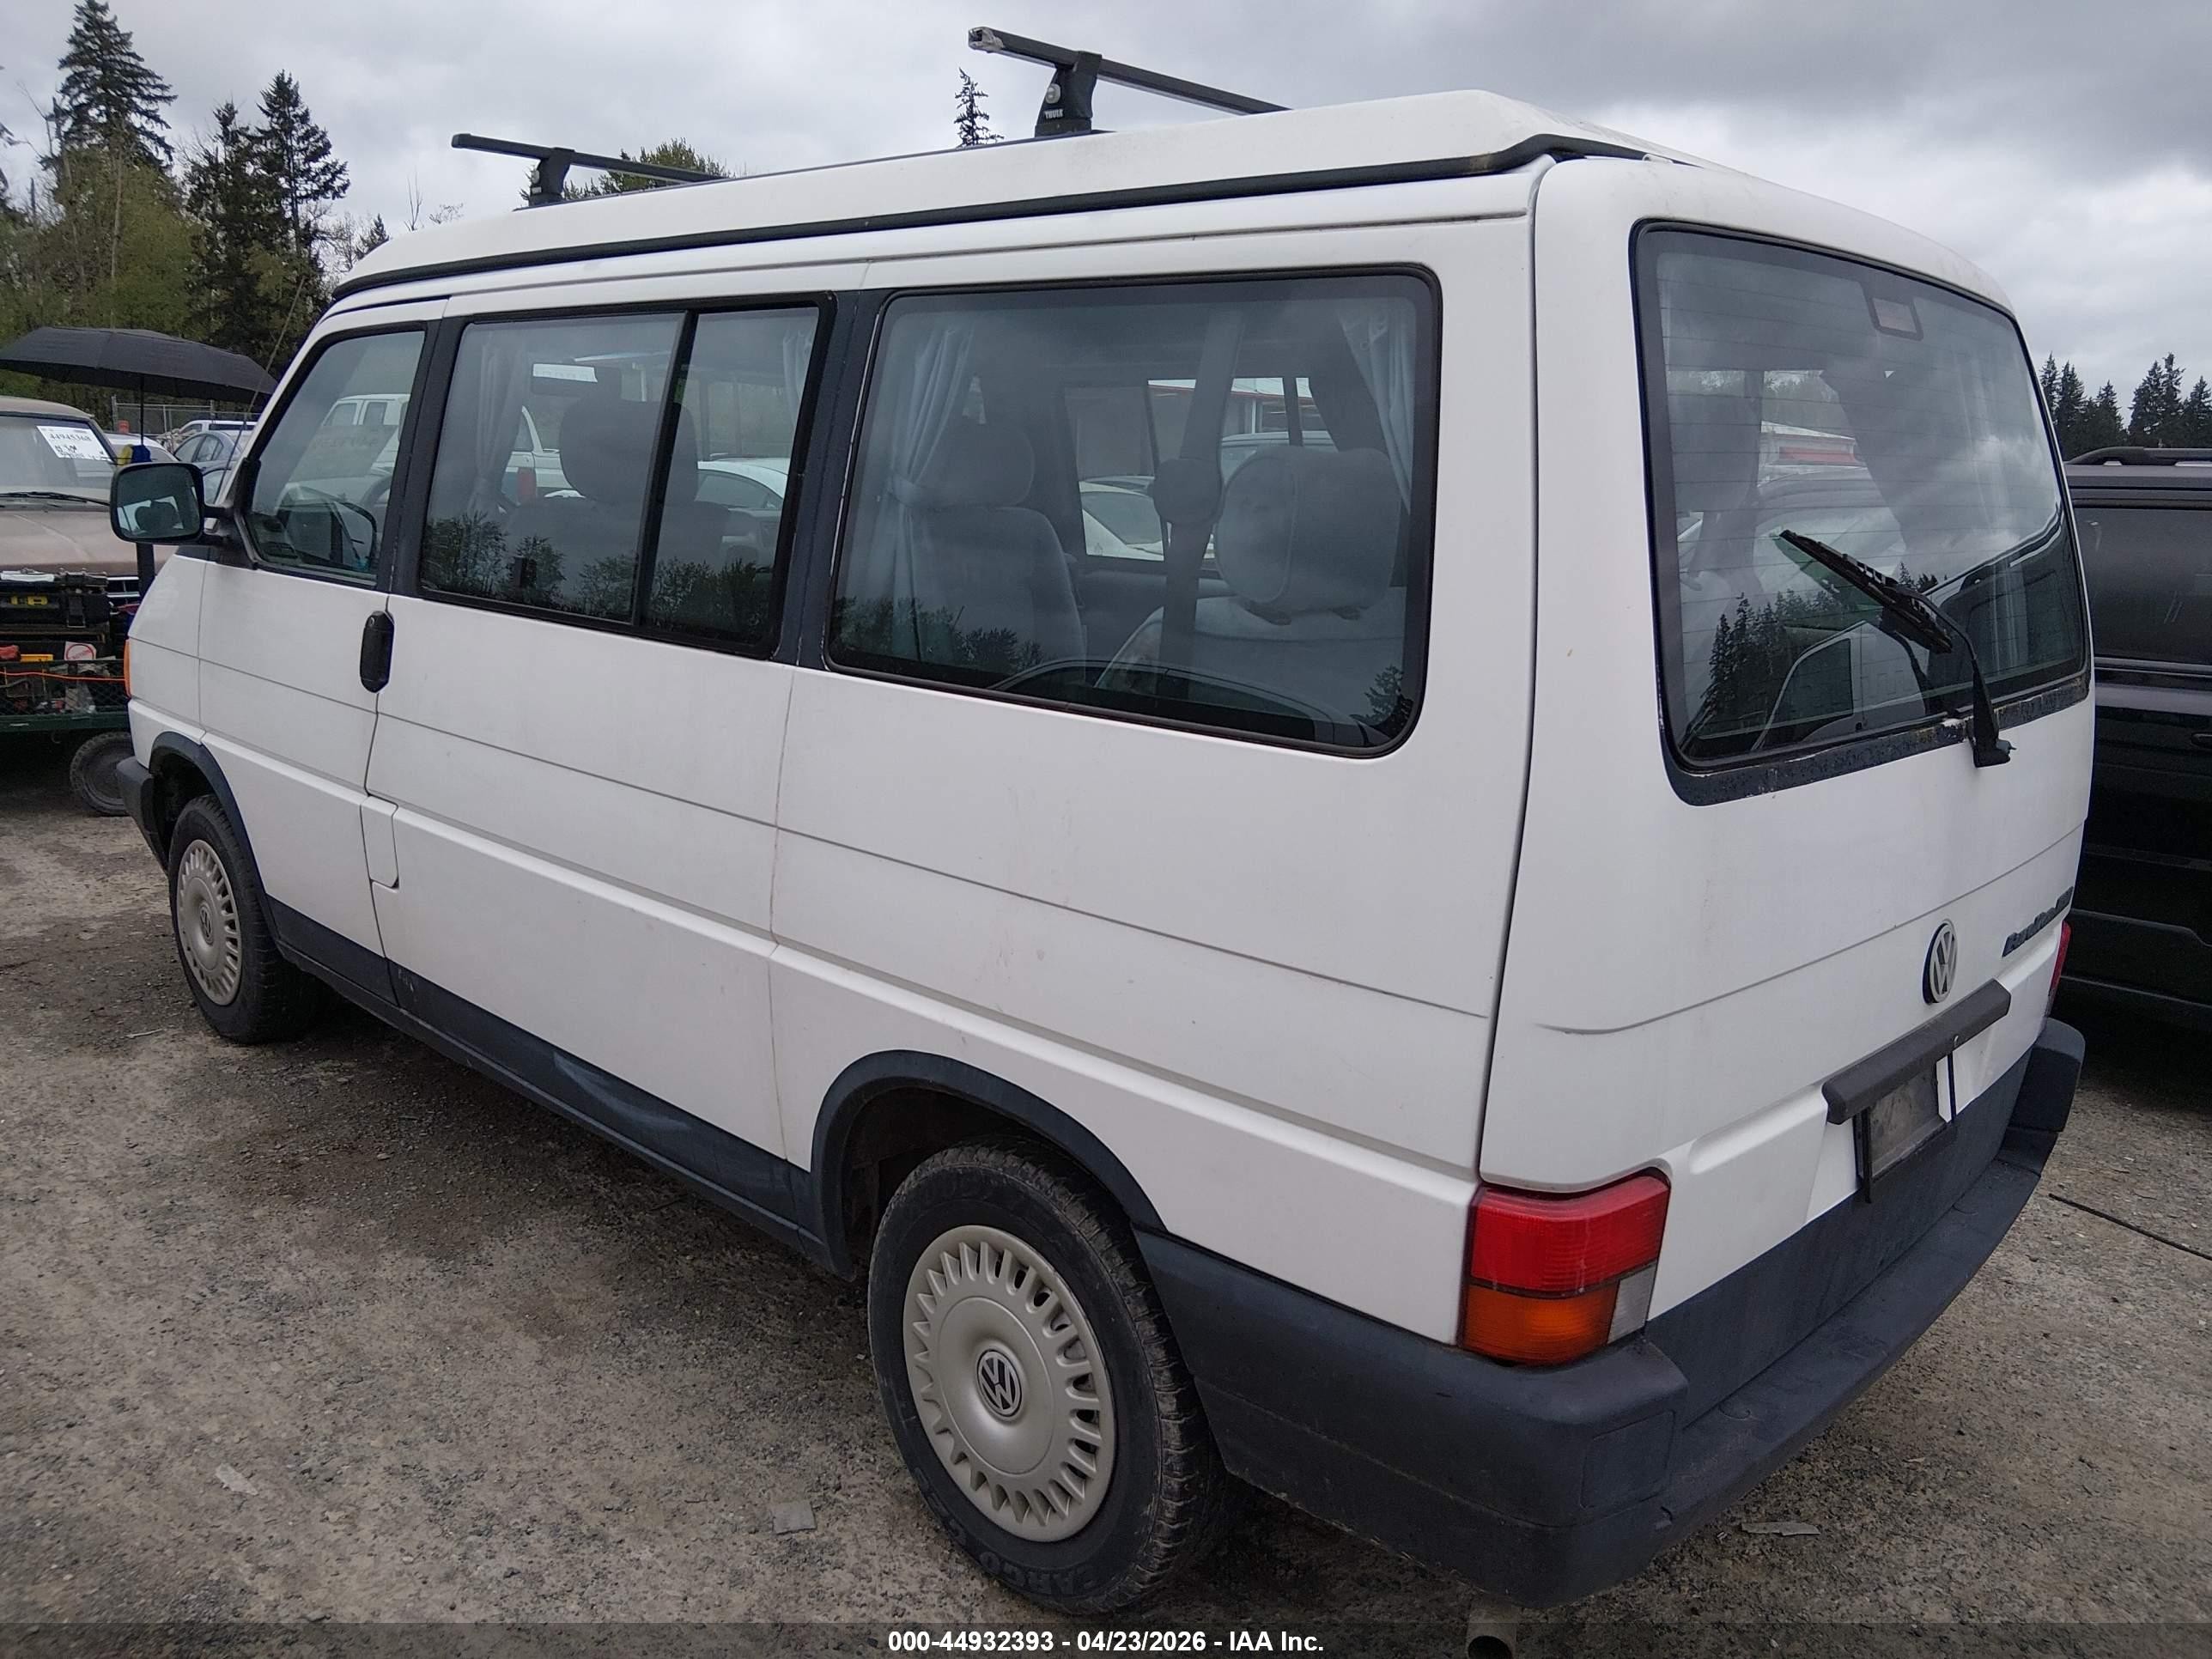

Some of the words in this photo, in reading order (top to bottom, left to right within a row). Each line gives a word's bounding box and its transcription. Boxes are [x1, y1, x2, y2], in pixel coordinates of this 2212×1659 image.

[1044, 108, 1064, 119] THULE
[1929, 922, 1958, 1003] VW
[979, 1351, 1022, 1418] VW
